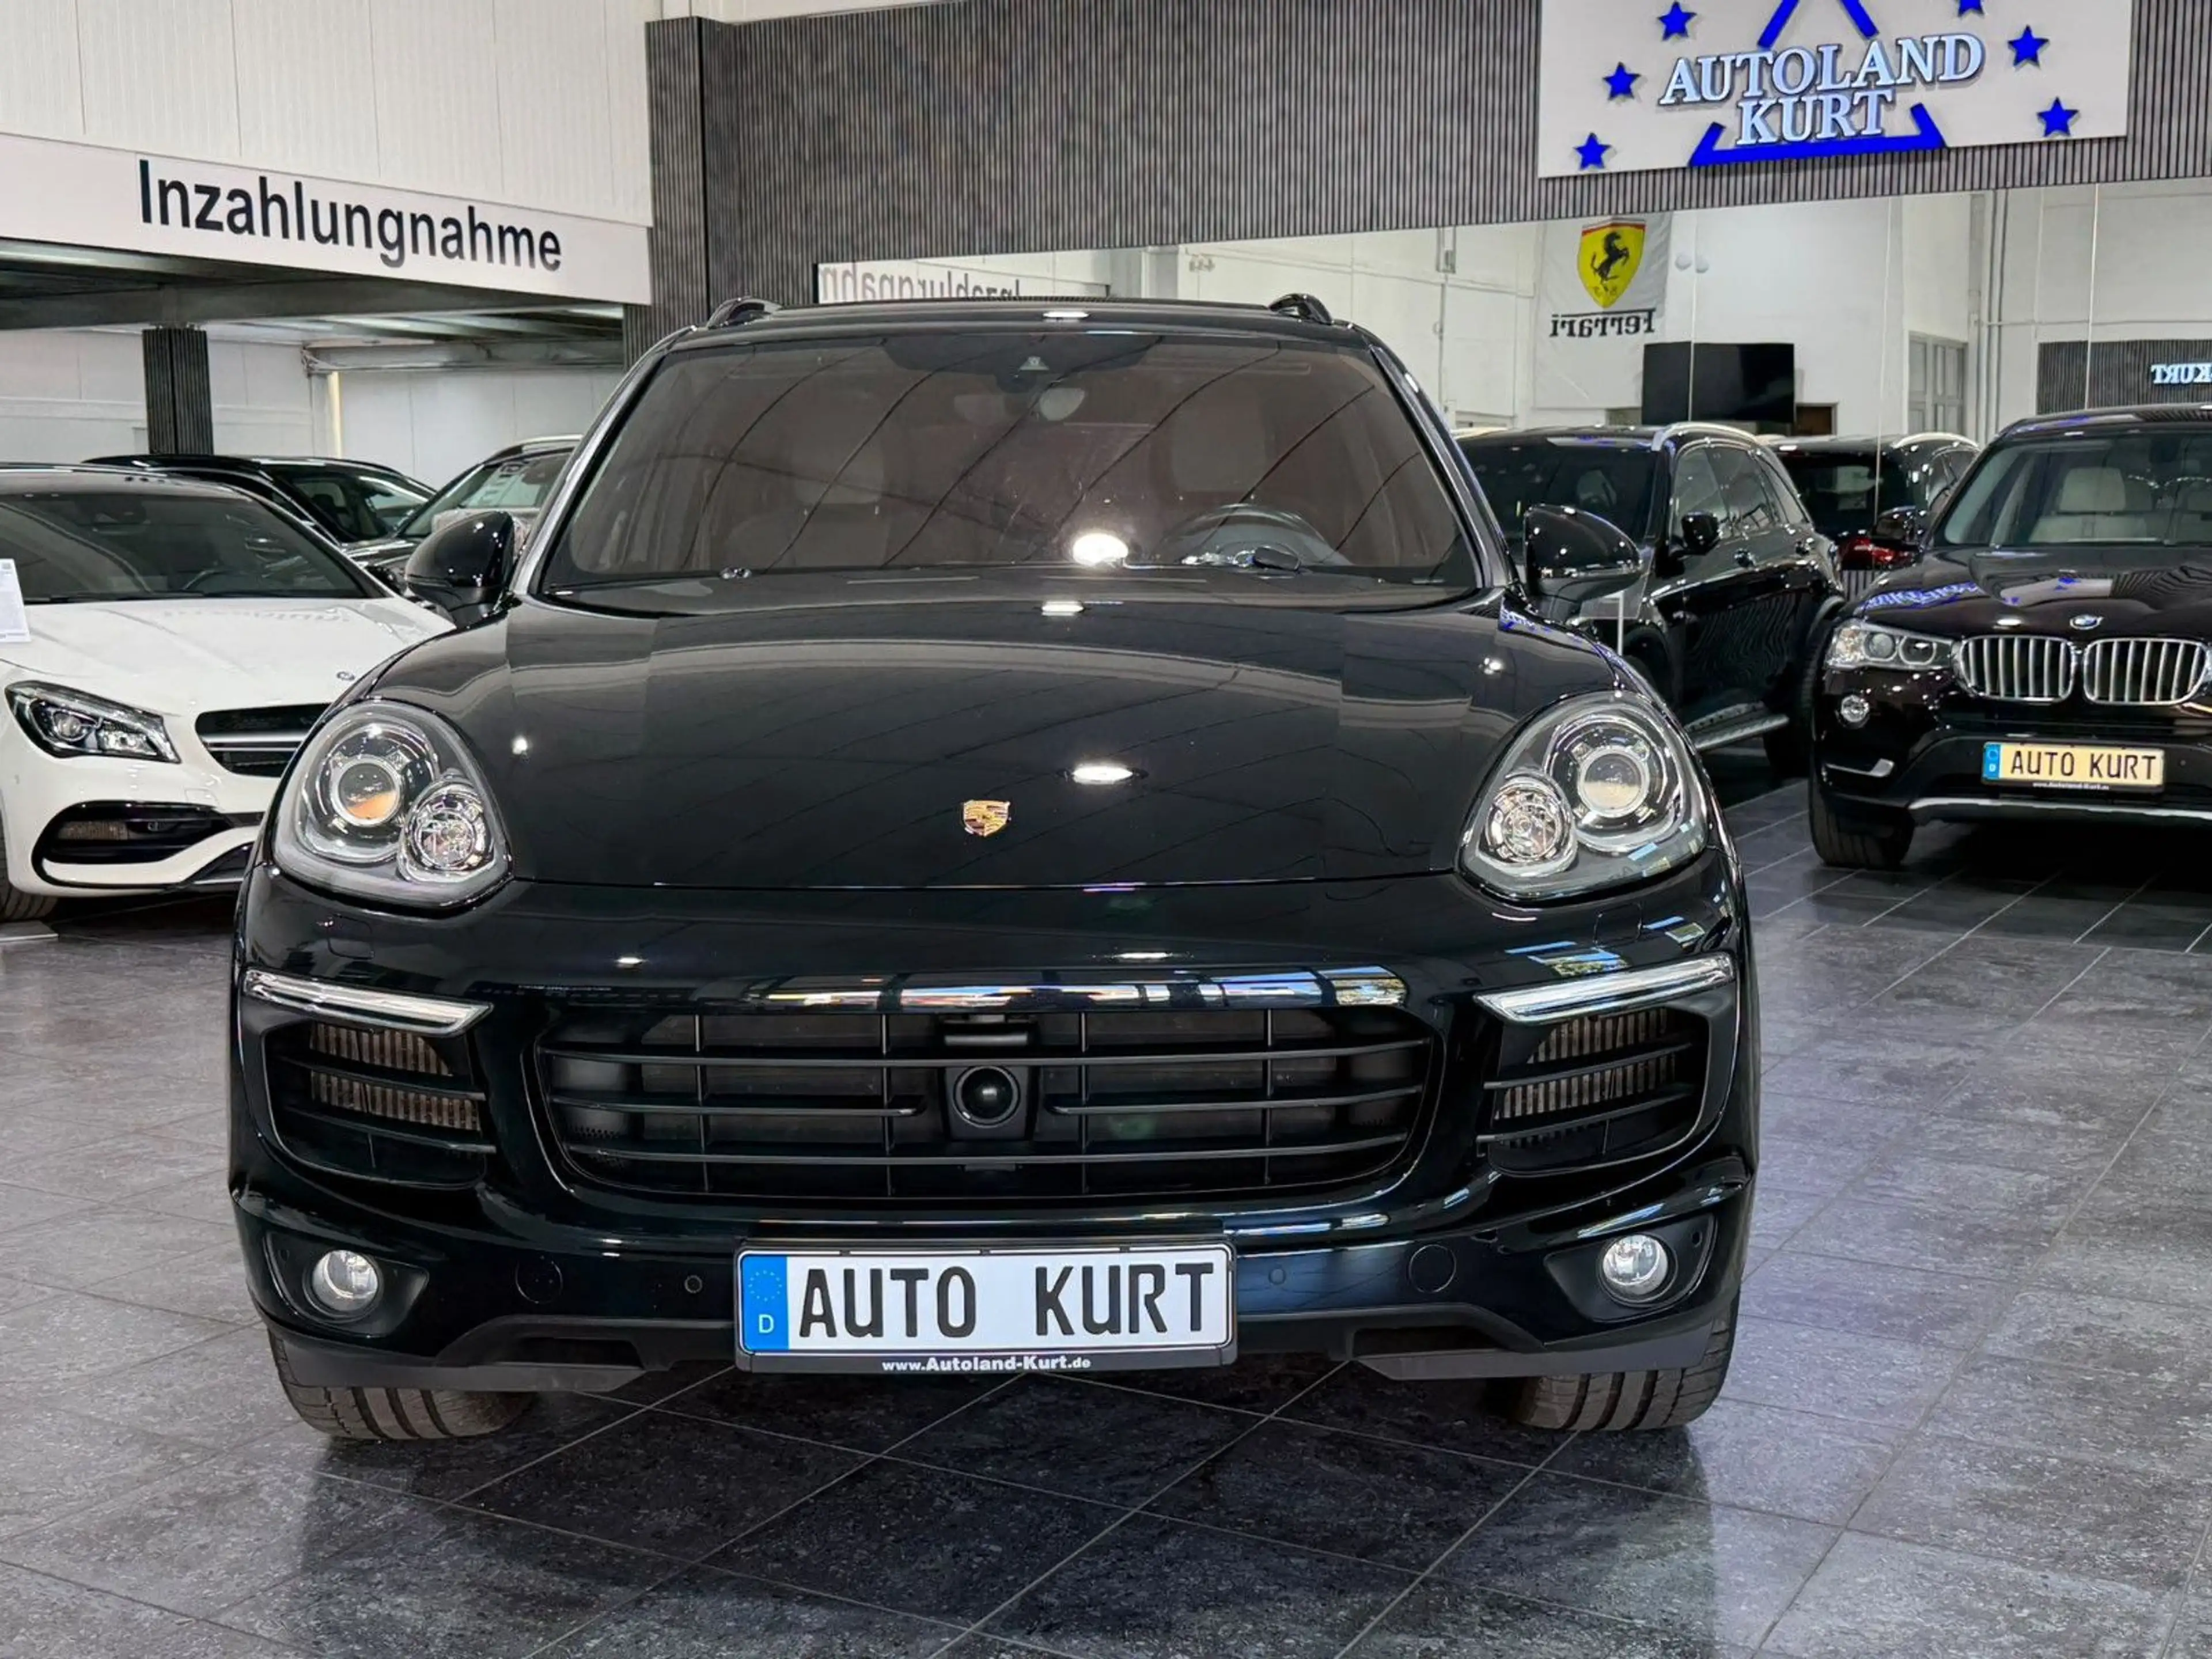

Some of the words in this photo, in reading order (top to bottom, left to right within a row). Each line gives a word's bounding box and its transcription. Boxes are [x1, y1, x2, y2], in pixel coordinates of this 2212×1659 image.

[1658, 33, 1986, 105] AUTOLAND
[1735, 88, 1893, 146] KURT
[138, 159, 562, 272] Inzahlungnahme
[2010, 750, 2074, 777] AUTO
[2089, 753, 2156, 780] KURT
[759, 1314, 774, 1334] D
[799, 1266, 976, 1338] AUTO
[1035, 1262, 1214, 1336] KURT
[881, 1356, 1092, 1372] www.Autoland-Kurt.de
